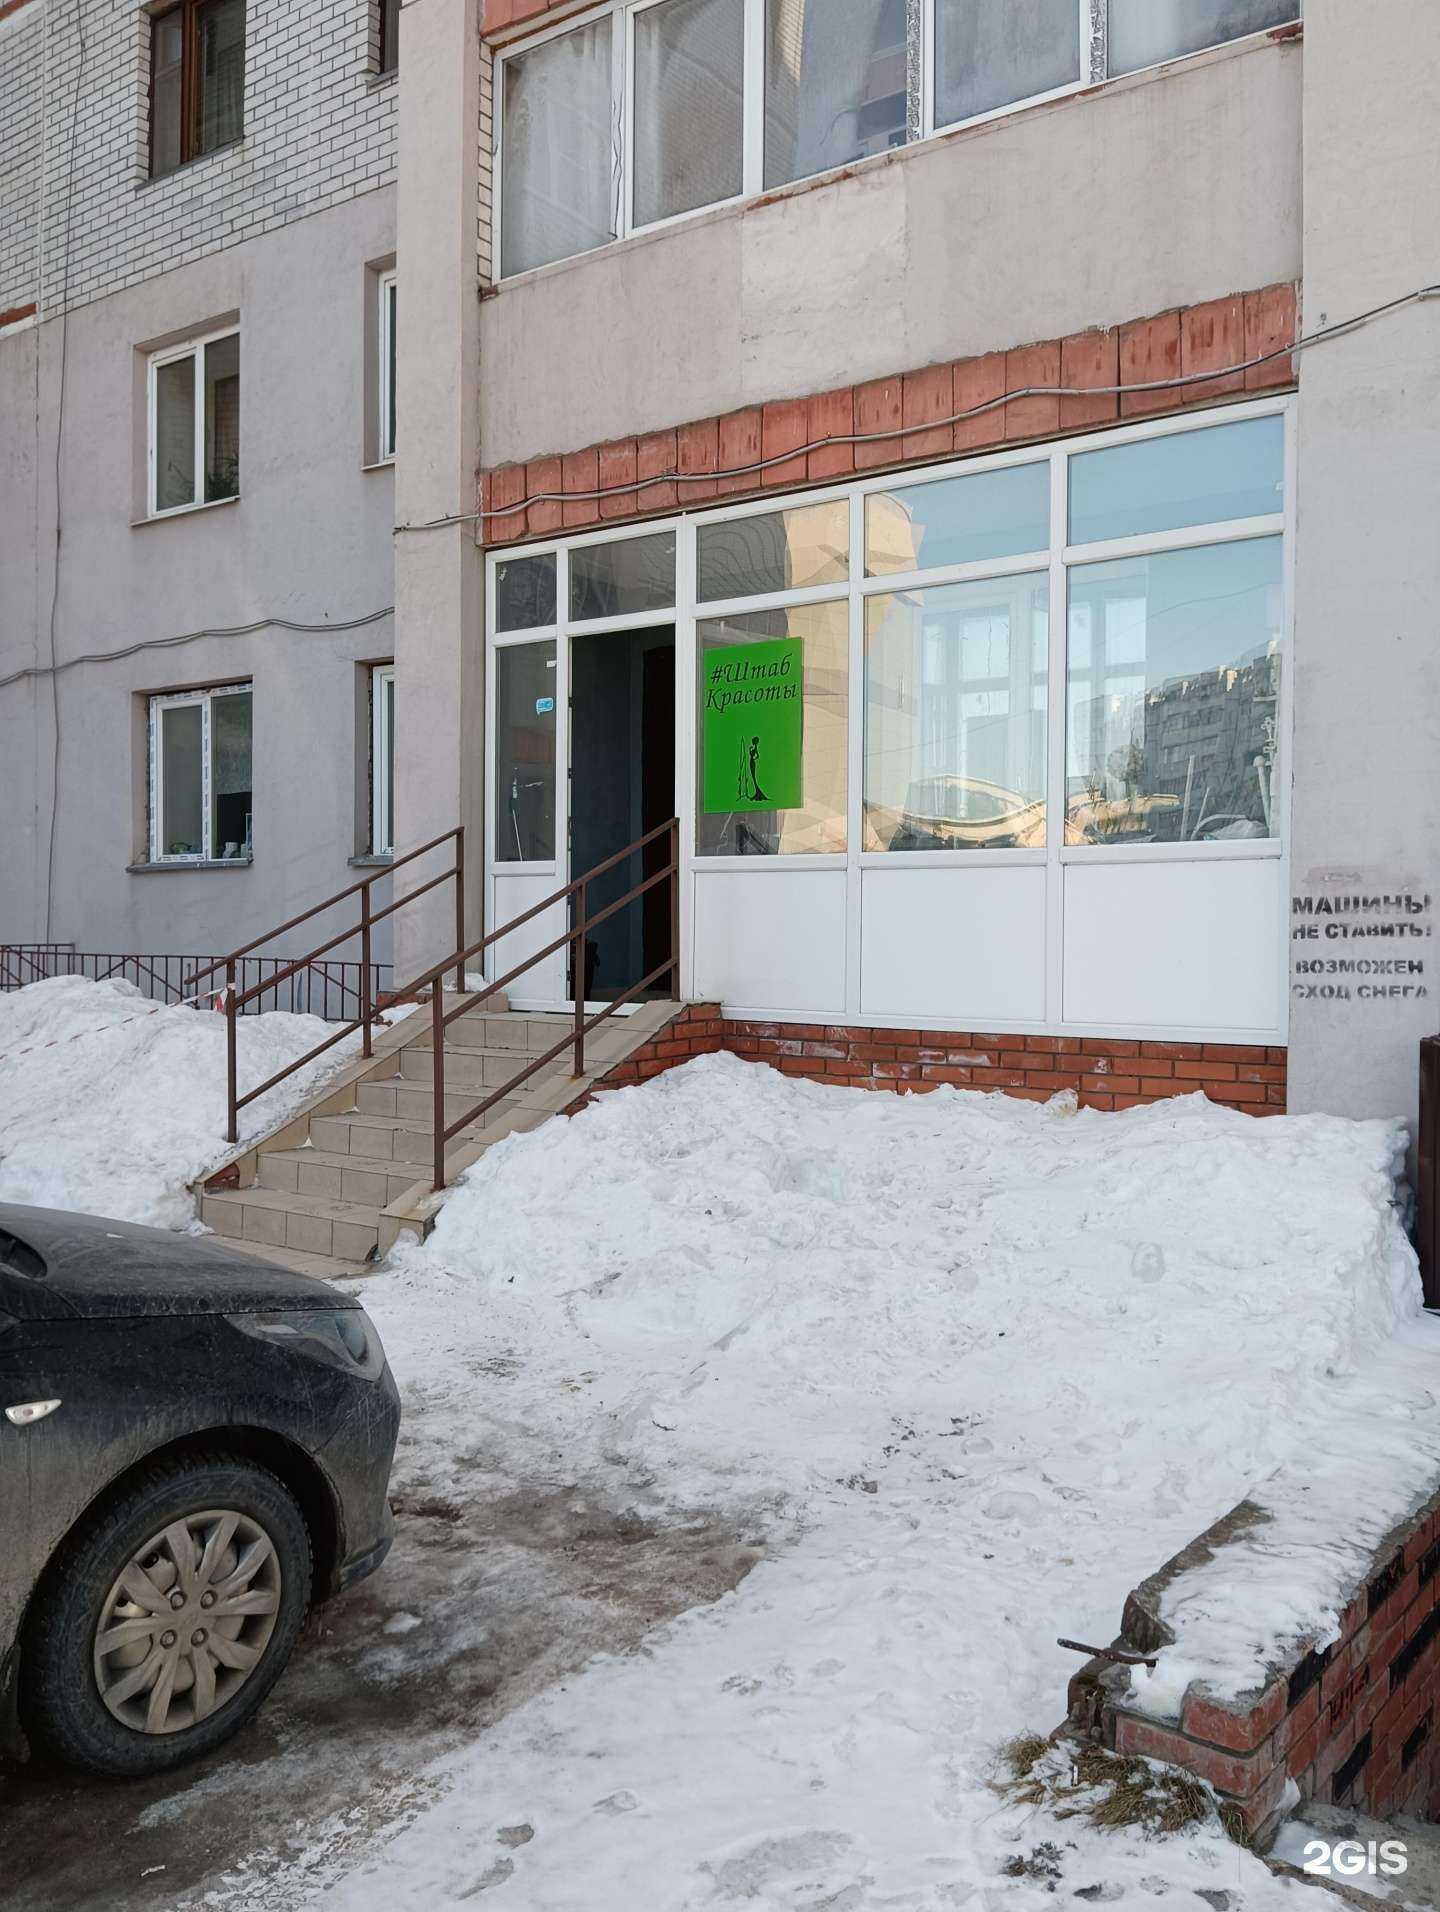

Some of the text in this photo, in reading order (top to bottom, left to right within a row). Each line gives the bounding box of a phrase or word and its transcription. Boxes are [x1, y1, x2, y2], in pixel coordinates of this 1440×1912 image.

[711, 653, 792, 684] #Штаб
[706, 683, 797, 713] Красоты
[1292, 894, 1431, 915] МАШИНЫ
[1292, 924, 1320, 940] НЕ
[1296, 960, 1424, 974] ВОЗМОЖЕН
[1292, 984, 1428, 1000] СХОД СНЕГА
